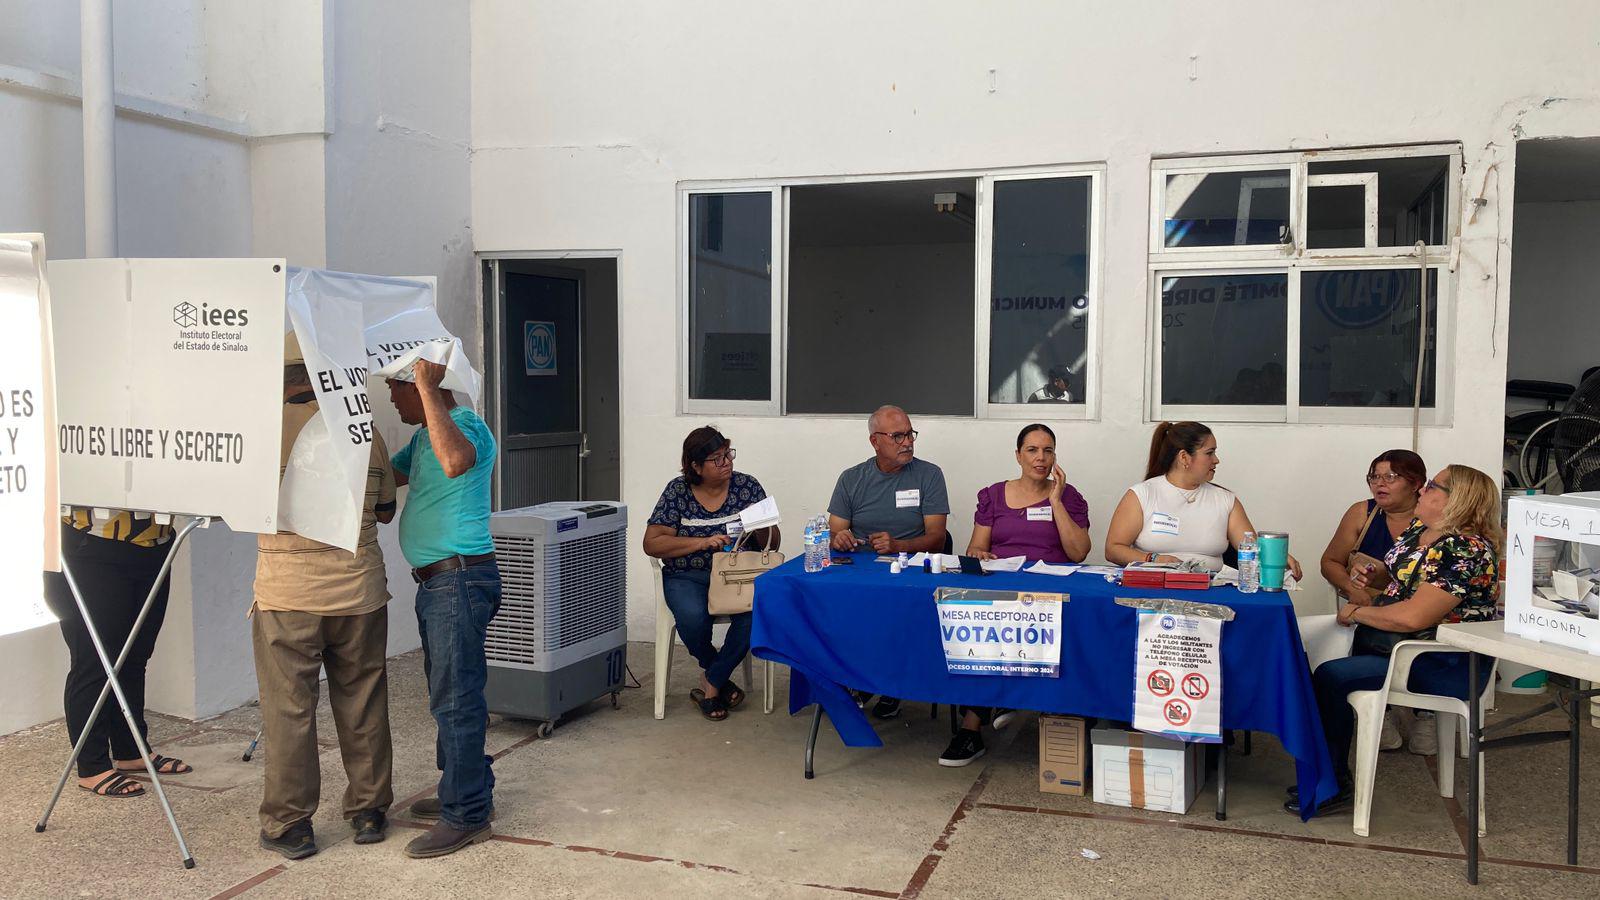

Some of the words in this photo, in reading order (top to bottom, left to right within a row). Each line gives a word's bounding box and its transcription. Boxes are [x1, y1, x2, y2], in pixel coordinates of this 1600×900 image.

[202, 302, 248, 327] iees
[173, 341, 184, 350] del
[186, 342, 210, 351] Estado
[212, 342, 220, 351] de
[222, 342, 248, 352] Sinaloa
[180, 330, 210, 339] Instituto
[212, 331, 242, 340] Electoral
[531, 335, 551, 358] PAN
[317, 369, 343, 393] EL
[11, 389, 34, 418] ES
[7, 427, 18, 455] Y
[58, 424, 84, 454] OTO
[89, 426, 105, 456] ES
[111, 427, 153, 459] LIBRE
[159, 429, 169, 459] Y
[174, 430, 243, 464] SECRETO
[1525, 510, 1570, 531] MESA
[1513, 533, 1525, 557] A
[942, 610, 971, 620] MESA
[974, 611, 1037, 622] RECEPTORA
[1039, 613, 1053, 622] DE
[1518, 612, 1587, 638] NACIONAL
[941, 623, 1054, 645] VOTACIÓN
[1157, 633, 1201, 642] AGRADECEMOS
